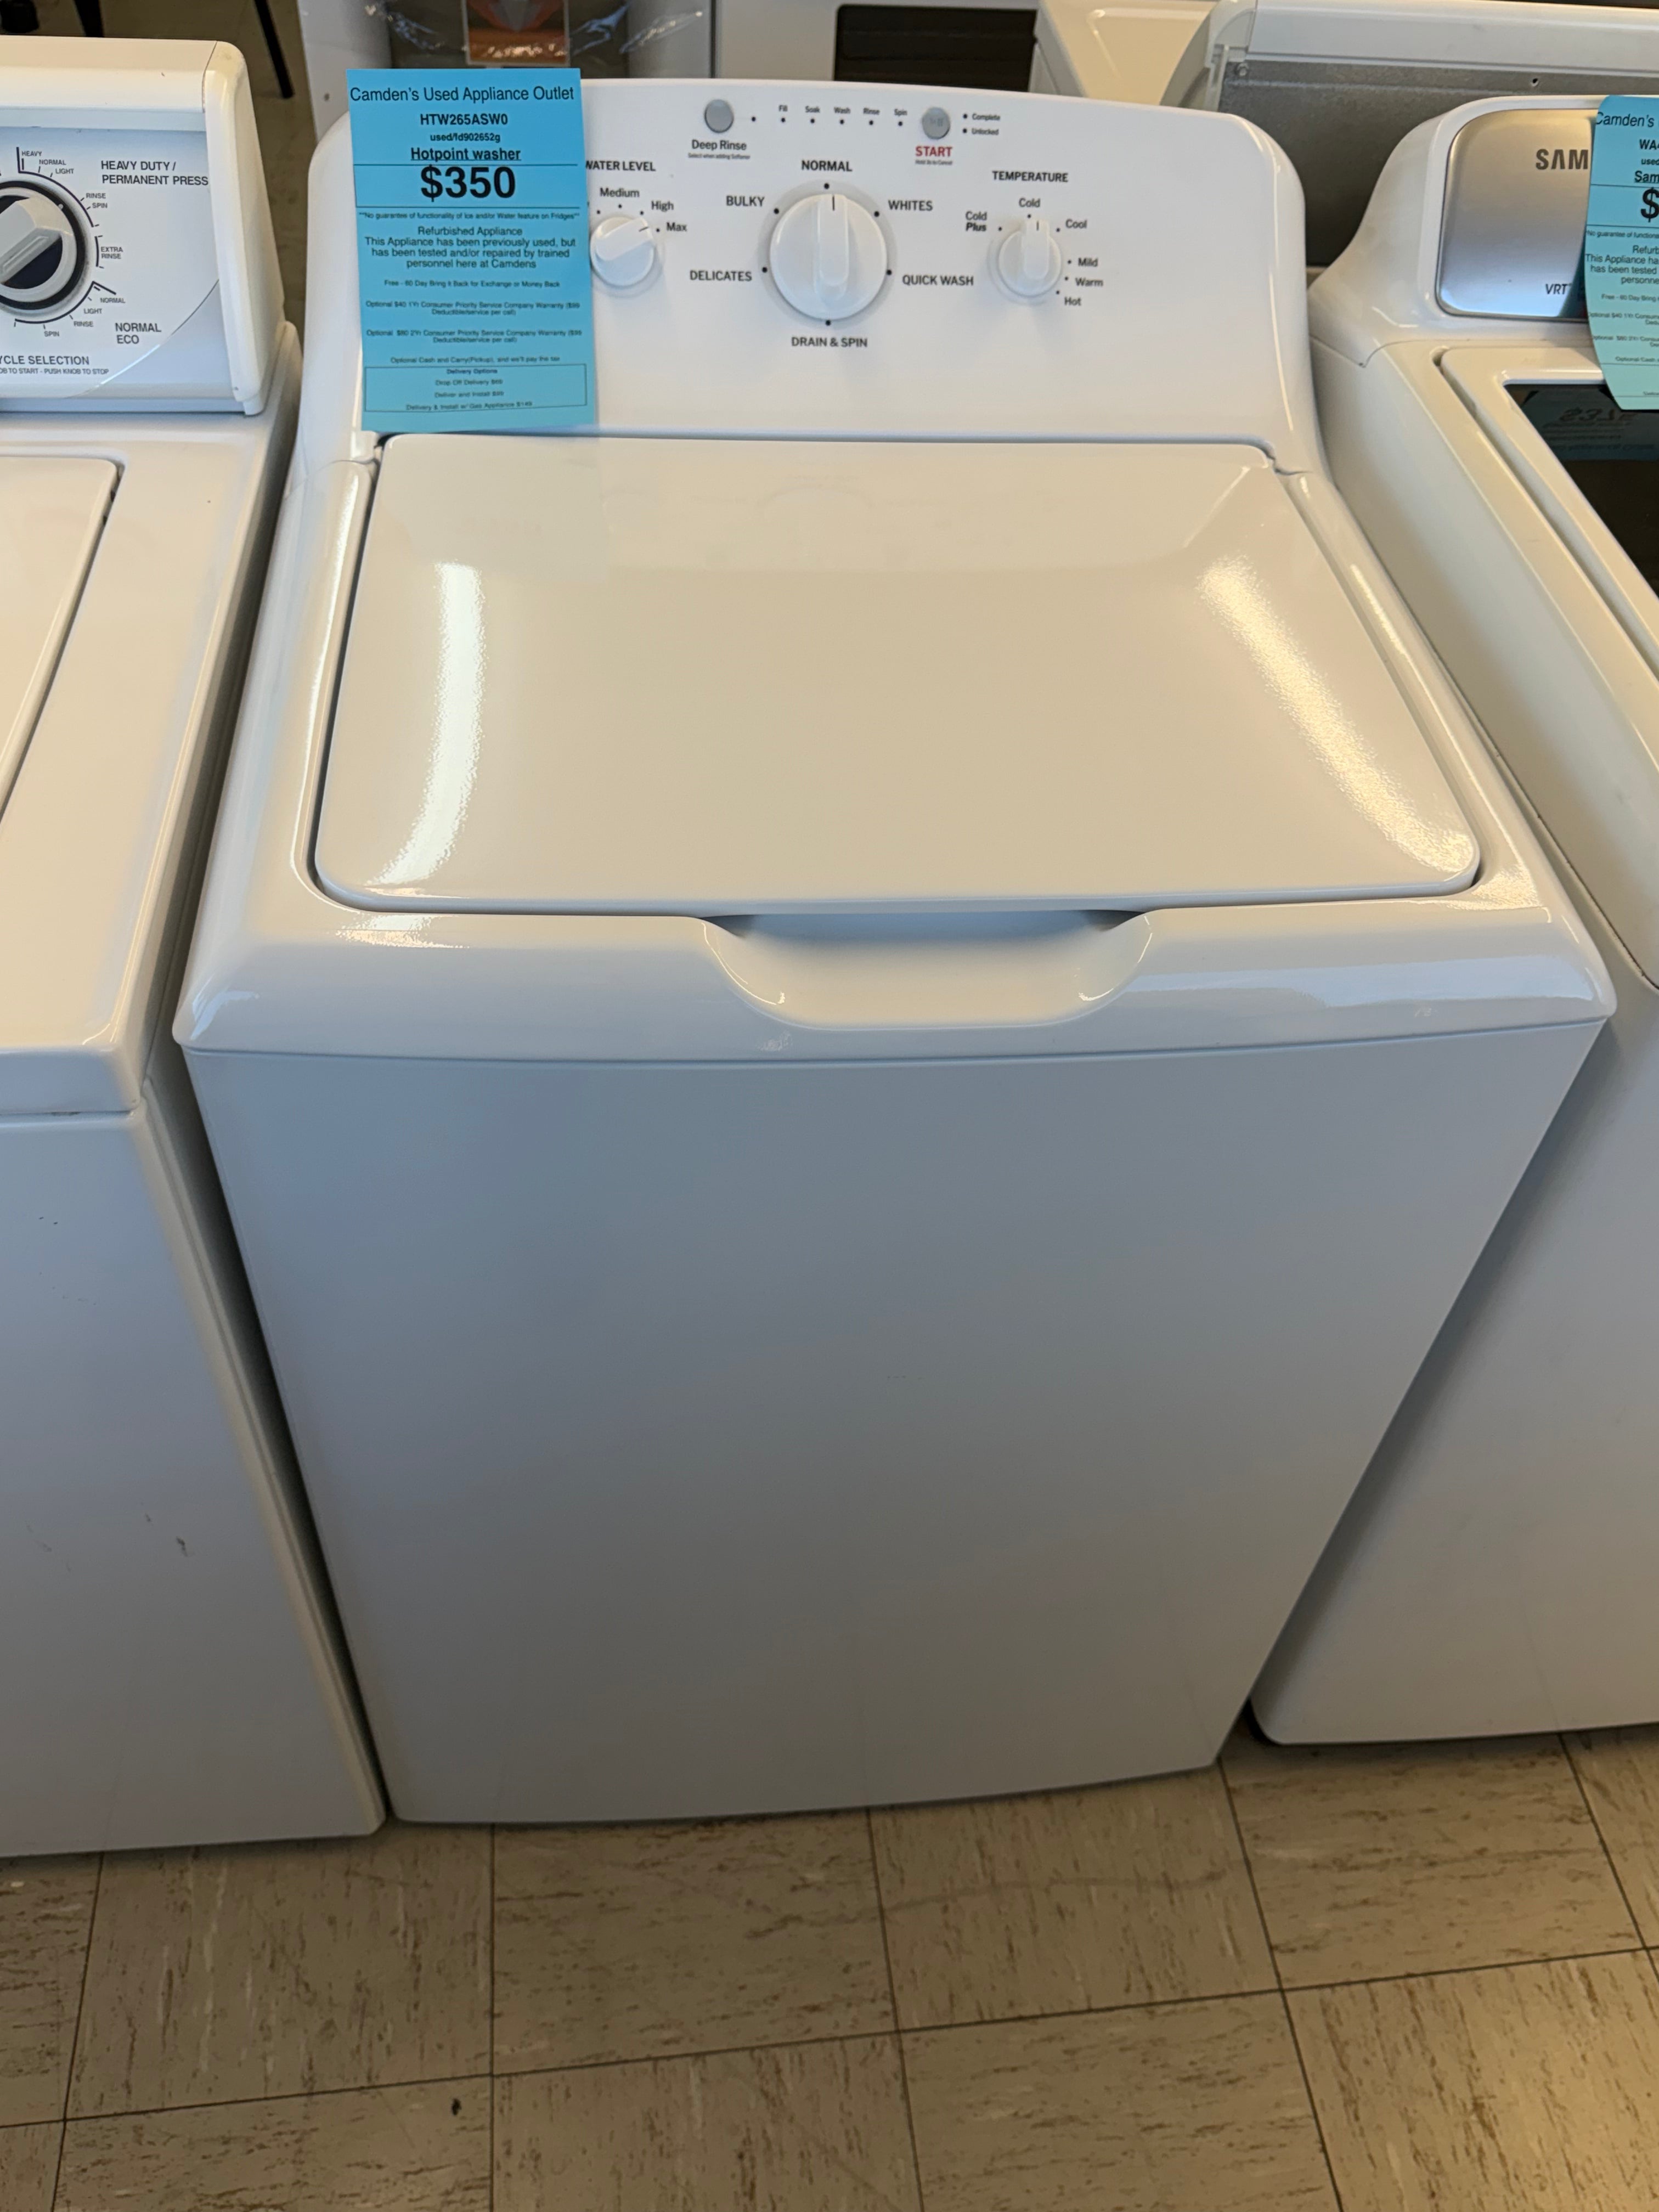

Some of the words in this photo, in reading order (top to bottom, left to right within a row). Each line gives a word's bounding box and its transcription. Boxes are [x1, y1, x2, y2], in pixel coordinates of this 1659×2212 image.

[350, 87, 419, 101] Camden's
[424, 88, 459, 100] Used
[463, 87, 528, 104] Appliance
[533, 86, 574, 100] Outlet
[420, 114, 508, 126] HTW265ASW0
[1596, 111, 1654, 127] Camden's
[692, 140, 717, 151] Deep
[720, 140, 747, 150] Rinse
[411, 148, 469, 161] Hotpoint
[473, 148, 521, 160] washer
[915, 146, 952, 157] START
[1536, 149, 1588, 170] SAM
[101, 161, 137, 170] HEAVY
[140, 161, 170, 171] DUTY
[623, 161, 656, 171] LEVEL
[802, 160, 852, 172] NORMAL
[102, 175, 169, 185] PERMANENT
[173, 176, 208, 185] PRESS
[992, 171, 1068, 182] TEMPERATURE
[421, 164, 515, 202] $350
[600, 188, 640, 198] Medium
[651, 201, 674, 212] High
[726, 196, 765, 207] BULKY
[888, 200, 933, 211] WHITES
[1019, 198, 1040, 208] Cold
[965, 211, 987, 221] Cold
[667, 222, 687, 232] Max
[965, 222, 986, 232] Plus
[1065, 219, 1087, 229] Cool
[417, 226, 474, 235] Refurbished
[477, 227, 522, 236] Appliance
[365, 236, 385, 245] This
[387, 237, 433, 247] Appliance
[482, 238, 529, 248] previously
[533, 238, 558, 247] used,
[561, 238, 576, 246] but
[371, 248, 389, 256] has
[418, 249, 447, 257] tested
[450, 249, 479, 257] and/or
[482, 249, 521, 258] repaired
[524, 249, 534, 259] by
[538, 249, 569, 257] trained
[1585, 253, 1603, 262] This
[1605, 255, 1646, 264] Appliance
[407, 259, 453, 268] personnel
[456, 259, 477, 268] here
[492, 259, 537, 268] Camdens
[1077, 257, 1098, 267] Mild
[1609, 265, 1629, 273] been
[1632, 266, 1657, 274] tested
[690, 270, 752, 281] DELICATES
[902, 275, 937, 286] QUICK
[940, 275, 974, 286] WASH
[1075, 278, 1103, 287] Warm
[1545, 284, 1567, 295] VRT
[1064, 297, 1081, 306] Hot
[115, 323, 161, 332] NORMAL
[116, 335, 139, 344] ECO
[792, 337, 827, 347] DRAIN
[830, 337, 838, 347] &
[841, 337, 867, 347] SPIN
[29, 356, 89, 365] SELECTION
